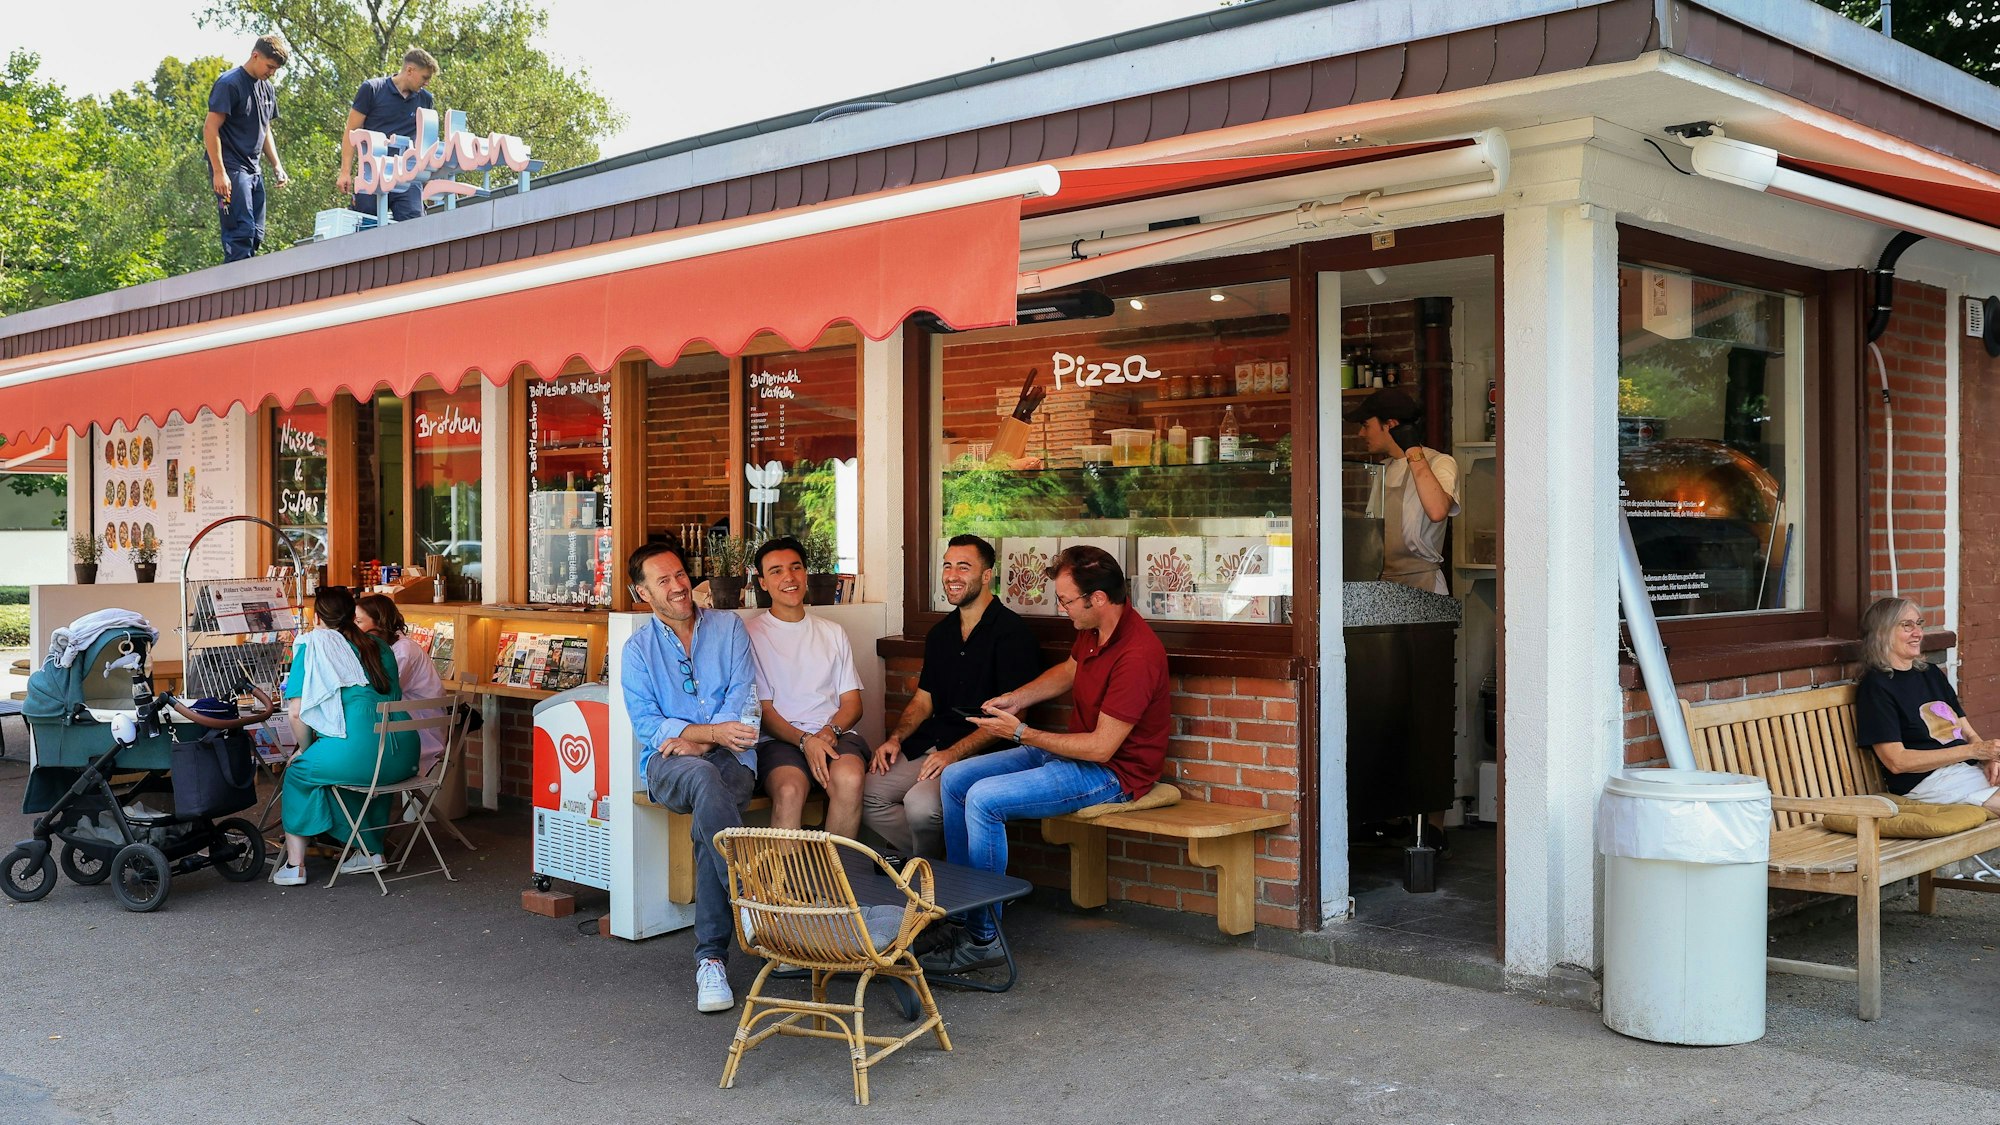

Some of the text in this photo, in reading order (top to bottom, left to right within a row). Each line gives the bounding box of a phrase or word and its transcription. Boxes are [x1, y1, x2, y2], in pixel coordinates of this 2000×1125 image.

[349, 107, 531, 196] Büdchen
[749, 368, 802, 388] Buttermilch
[1051, 350, 1162, 390] Pizza
[528, 376, 611, 398] Bottleshop Bottleshop
[760, 385, 795, 399] Waffeln
[280, 418, 315, 454] Nüsse
[415, 405, 481, 438] Brötchen
[528, 400, 538, 473] Bottleshop
[602, 391, 612, 469] Bottleshop
[294, 457, 303, 481] &
[278, 487, 319, 517] Süßes
[529, 587, 612, 606] Bottleshop Bottleshop
